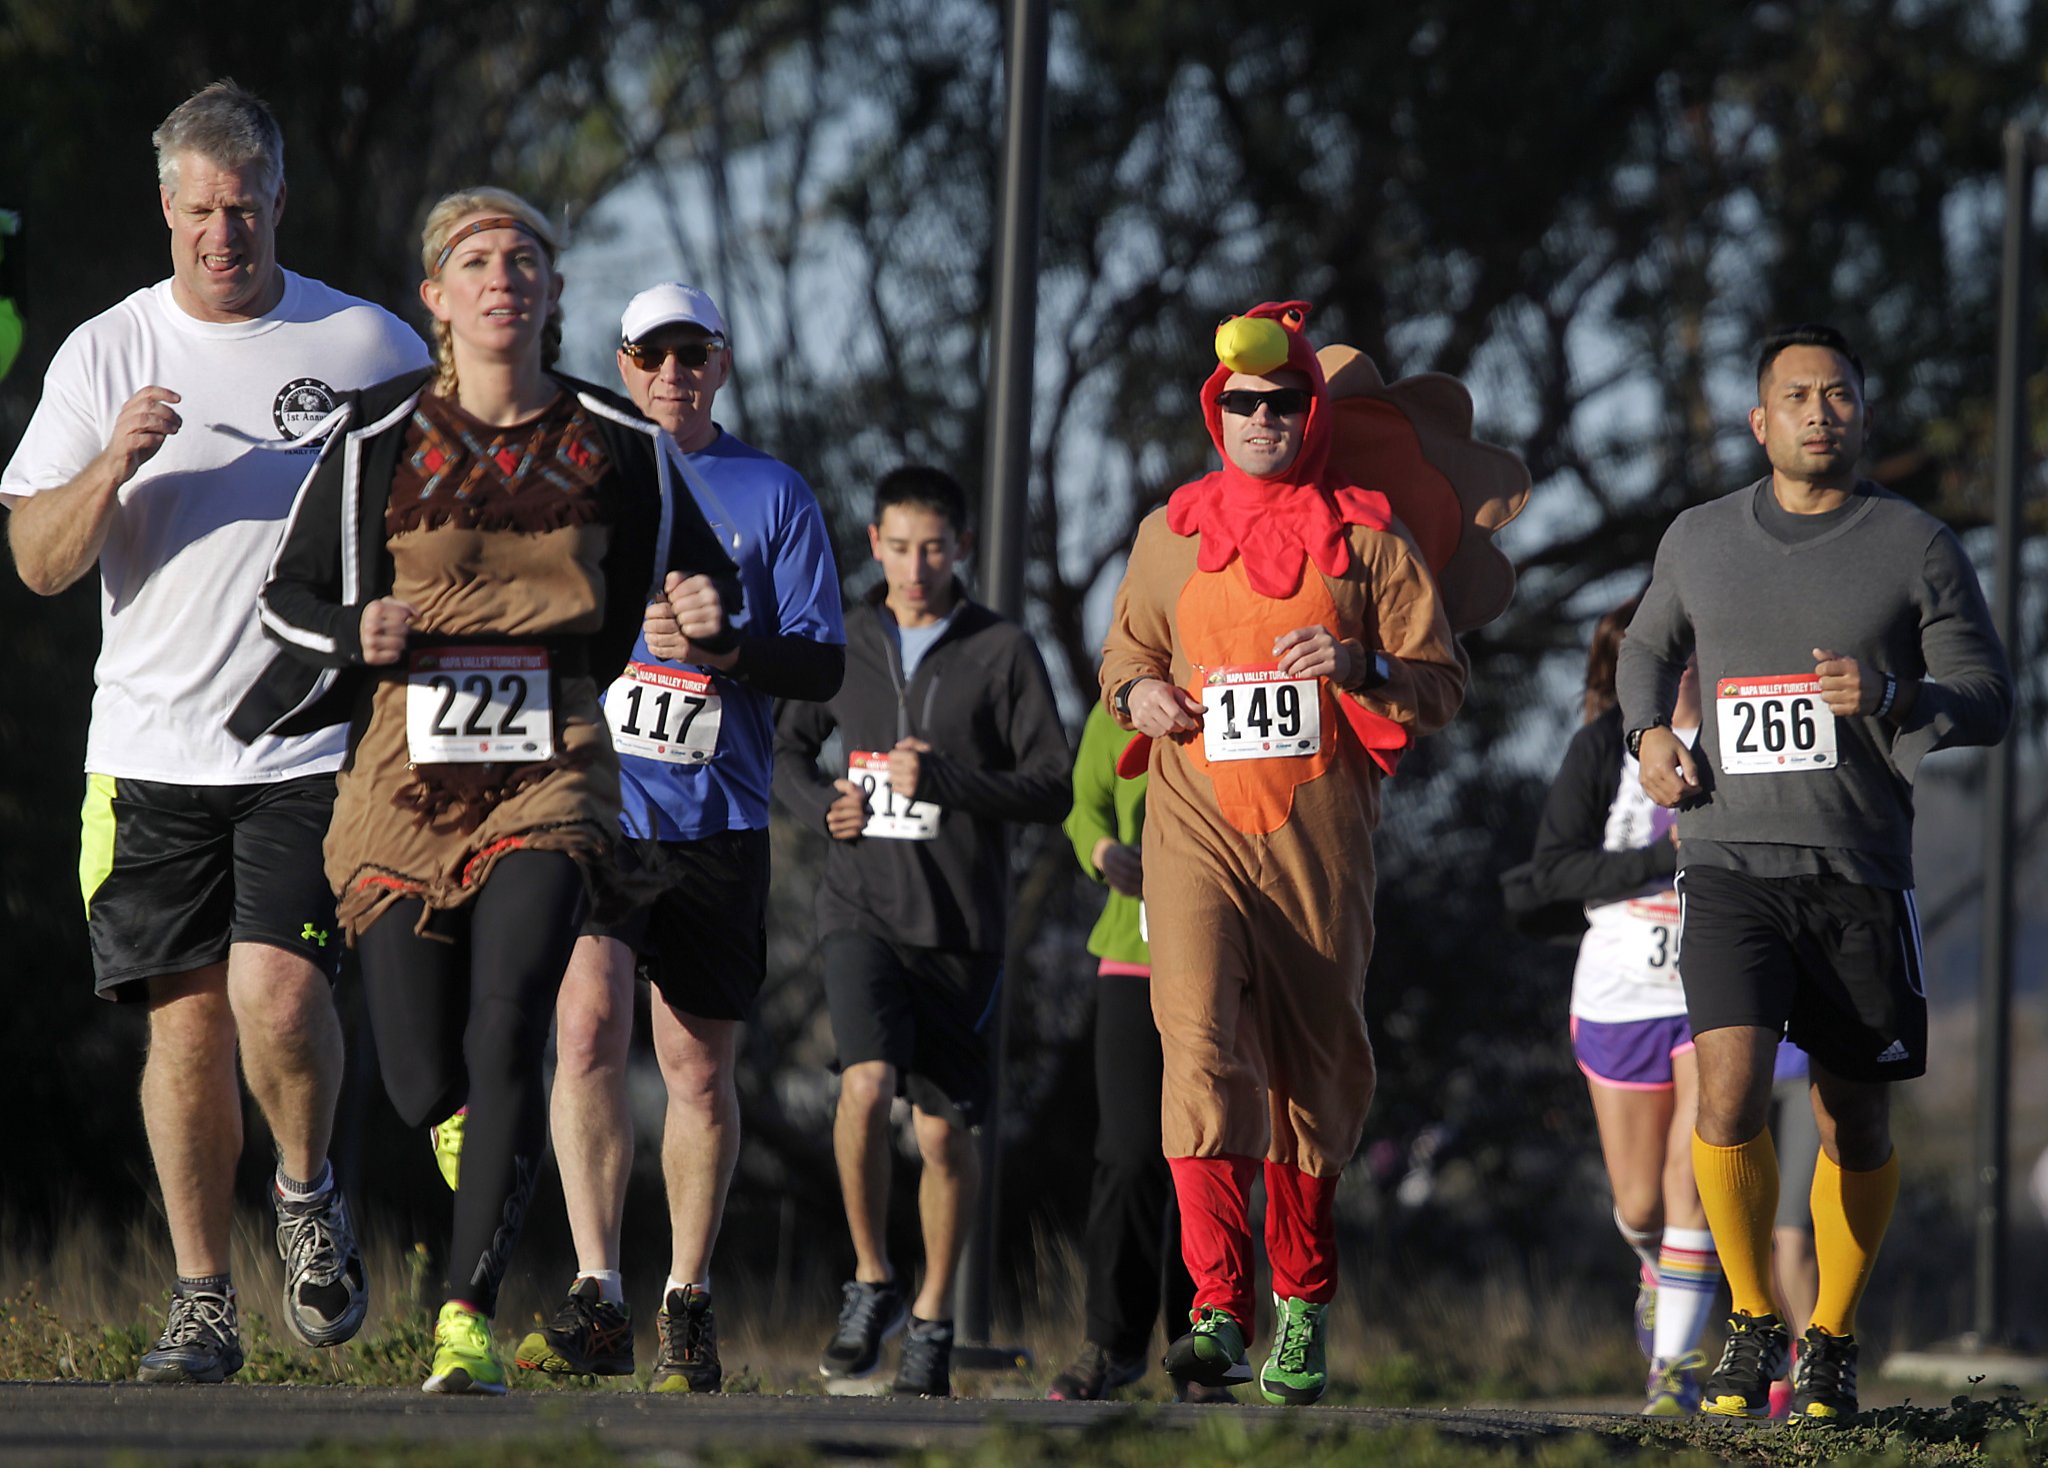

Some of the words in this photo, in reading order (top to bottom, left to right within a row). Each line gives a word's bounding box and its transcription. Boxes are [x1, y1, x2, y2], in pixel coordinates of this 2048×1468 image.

[287, 413, 299, 422] 1st
[302, 413, 326, 422] Annu
[640, 671, 657, 682] NAPA
[657, 674, 682, 688] VALLEY
[682, 679, 707, 692] TURKEY
[1226, 672, 1243, 683] NAPA
[1244, 671, 1268, 682] VALLEY
[1740, 686, 1757, 696] NAPA
[1758, 684, 1782, 695] VALLEY
[1783, 682, 1808, 693] TURKEY
[428, 674, 527, 736] 222
[620, 685, 706, 744] 117
[1220, 684, 1301, 740] 149
[1733, 698, 1816, 753] 266
